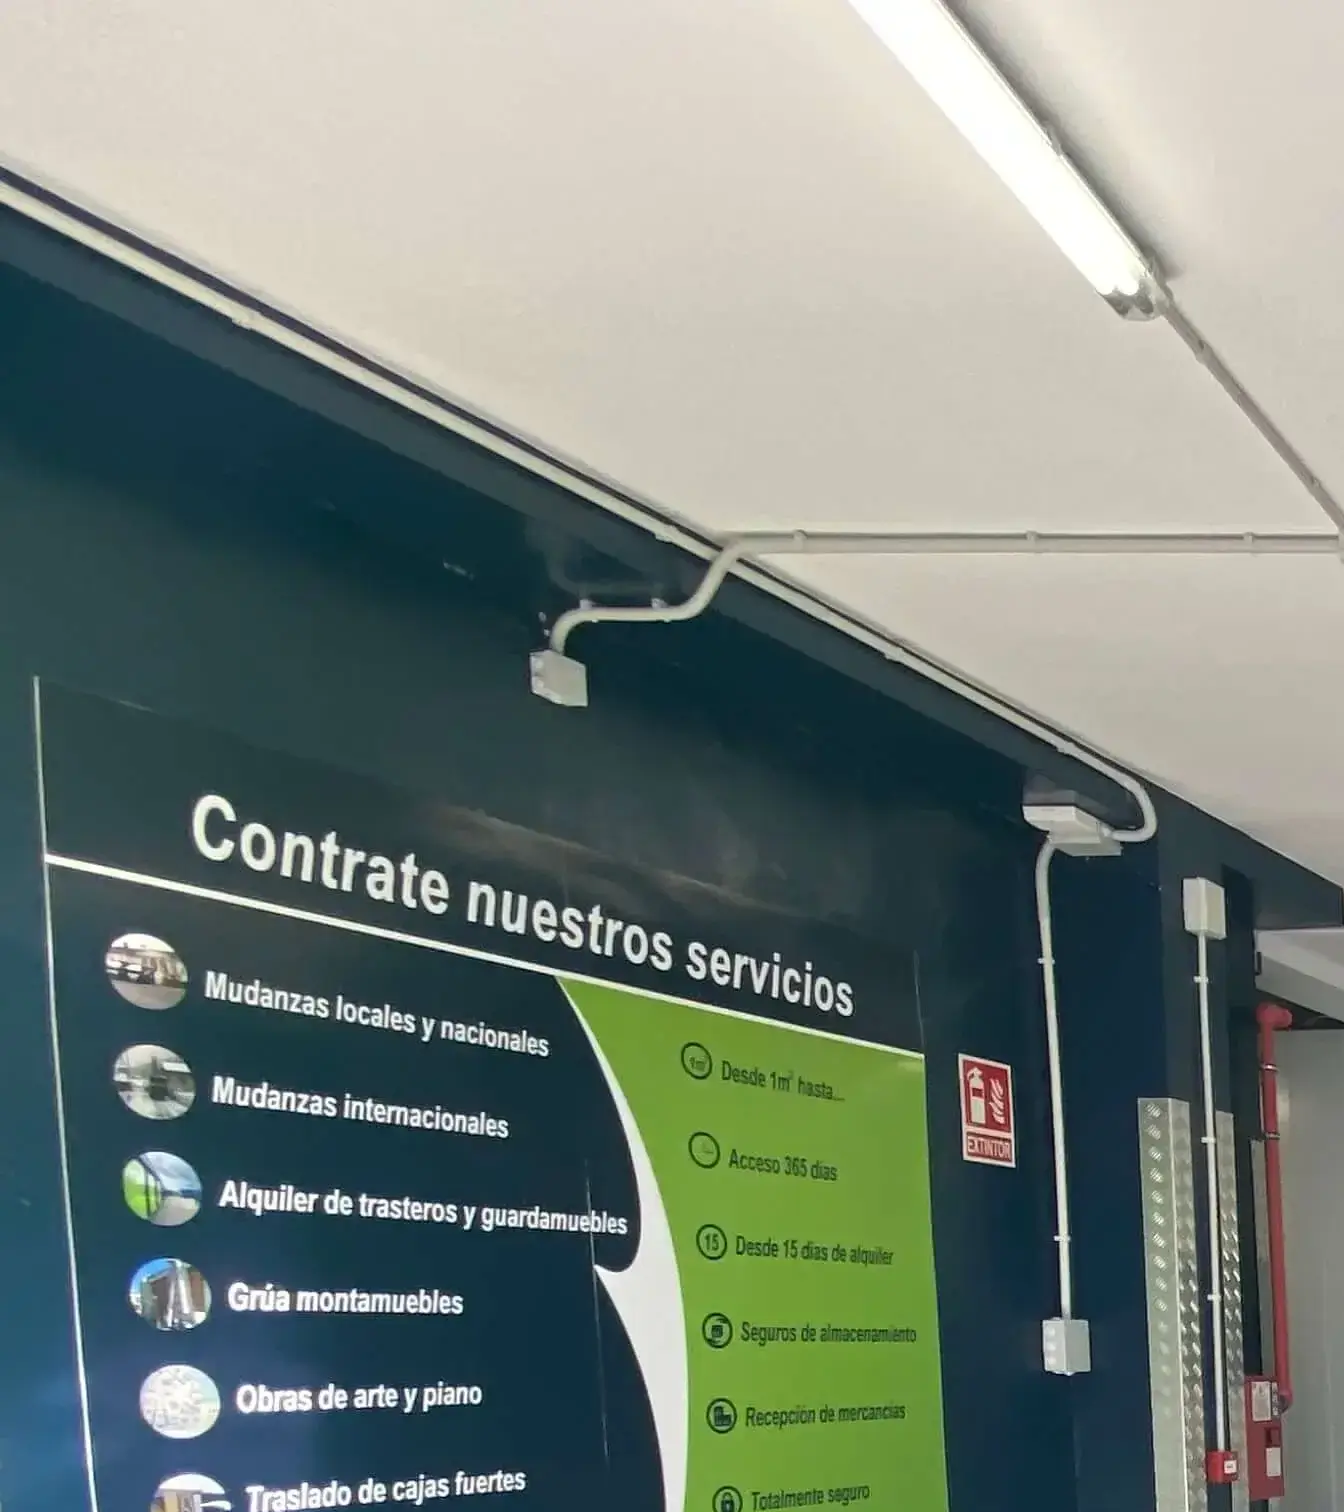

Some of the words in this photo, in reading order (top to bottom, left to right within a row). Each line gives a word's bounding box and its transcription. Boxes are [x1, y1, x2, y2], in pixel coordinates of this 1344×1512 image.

[192, 794, 450, 915] Contrate
[467, 880, 673, 972] nuestros
[686, 941, 855, 1017] servicios
[204, 970, 330, 1019] Mudanzas
[336, 995, 416, 1034] locales
[421, 1017, 437, 1042] y
[441, 1019, 550, 1057] nacionales
[722, 1060, 766, 1087] Desde
[212, 1075, 338, 1117] Mudanzas
[343, 1093, 510, 1139] internacionales
[728, 1149, 780, 1174] Acceso
[784, 1155, 807, 1178] 365
[968, 1136, 1011, 1160] EXTINTOR
[219, 1180, 319, 1216] Alquiler
[324, 1189, 353, 1216] de
[359, 1192, 458, 1225] trasteros
[463, 1206, 477, 1230] y
[481, 1205, 628, 1235] guardamuebles
[704, 1233, 719, 1251] 15
[735, 1235, 779, 1257] Desde
[783, 1240, 798, 1259] 15
[832, 1244, 847, 1263] de
[850, 1246, 894, 1267] alquiler
[227, 1281, 290, 1313] Grúa
[296, 1288, 464, 1315] montamuebles
[741, 1321, 796, 1346] Seguros
[801, 1322, 816, 1342] de
[820, 1323, 917, 1343] almacenamiento
[236, 1383, 313, 1414] Obras
[318, 1383, 348, 1410] de
[354, 1384, 398, 1409] arte
[402, 1385, 418, 1413] y
[422, 1380, 483, 1412] piano
[745, 1404, 816, 1429] Recepción
[820, 1405, 836, 1422] de
[358, 1478, 387, 1504] de
[392, 1473, 450, 1505] cajas
[454, 1470, 527, 1495] fuertes
[752, 1488, 824, 1512] Totalmente
[828, 1485, 870, 1506] seguro
